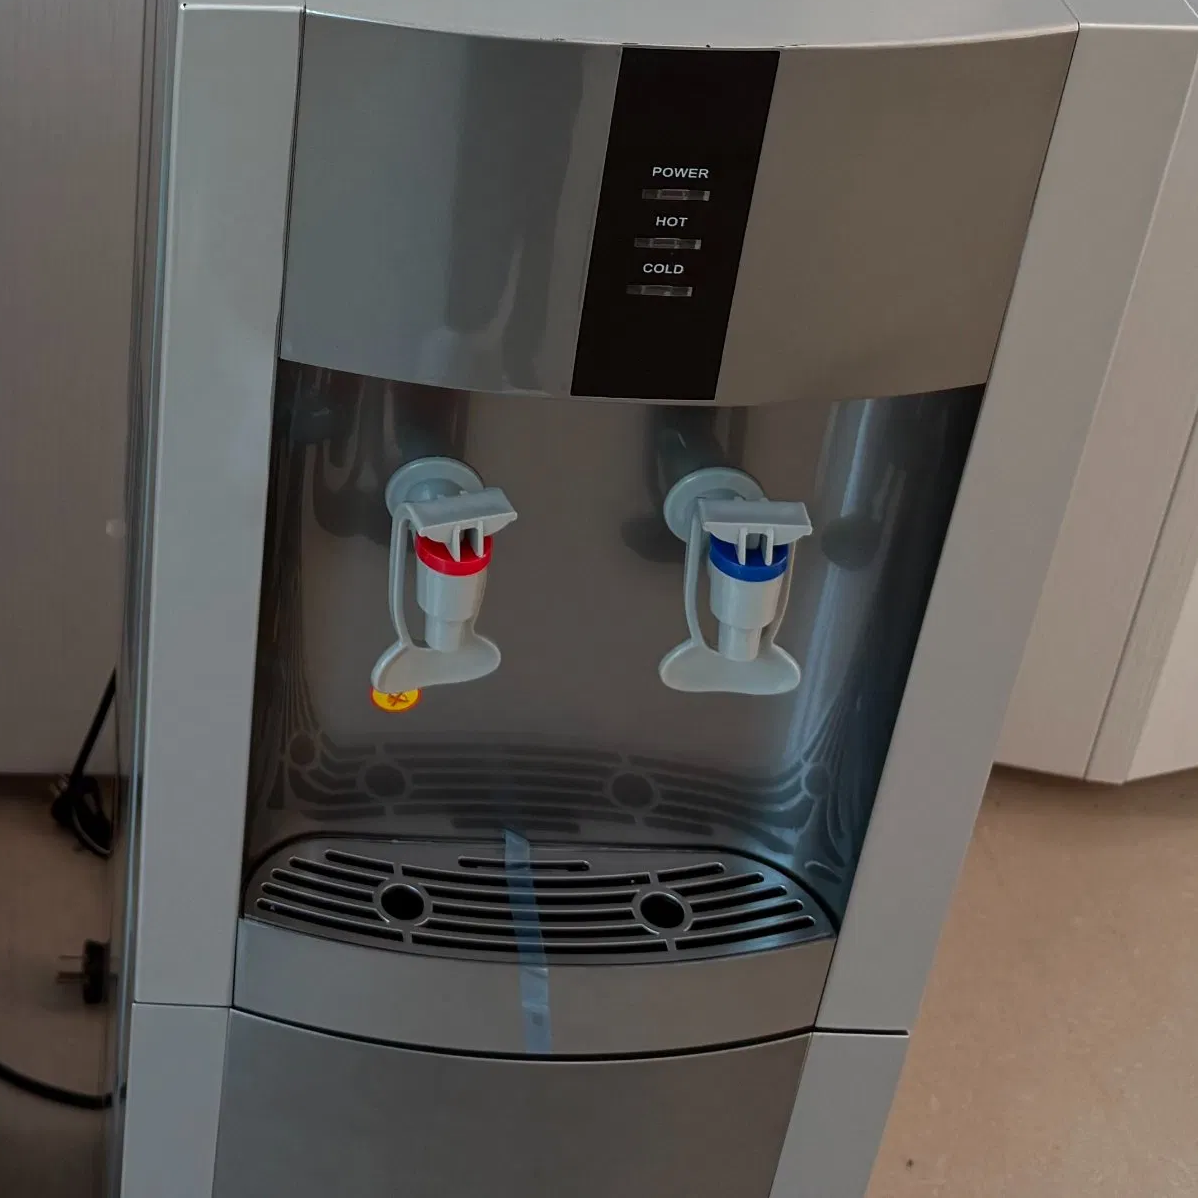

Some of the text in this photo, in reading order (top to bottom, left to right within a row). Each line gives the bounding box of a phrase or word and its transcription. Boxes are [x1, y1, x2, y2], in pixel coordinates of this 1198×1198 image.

[652, 166, 709, 179] POWER
[655, 216, 688, 227] HOT
[642, 263, 684, 275] COLD
